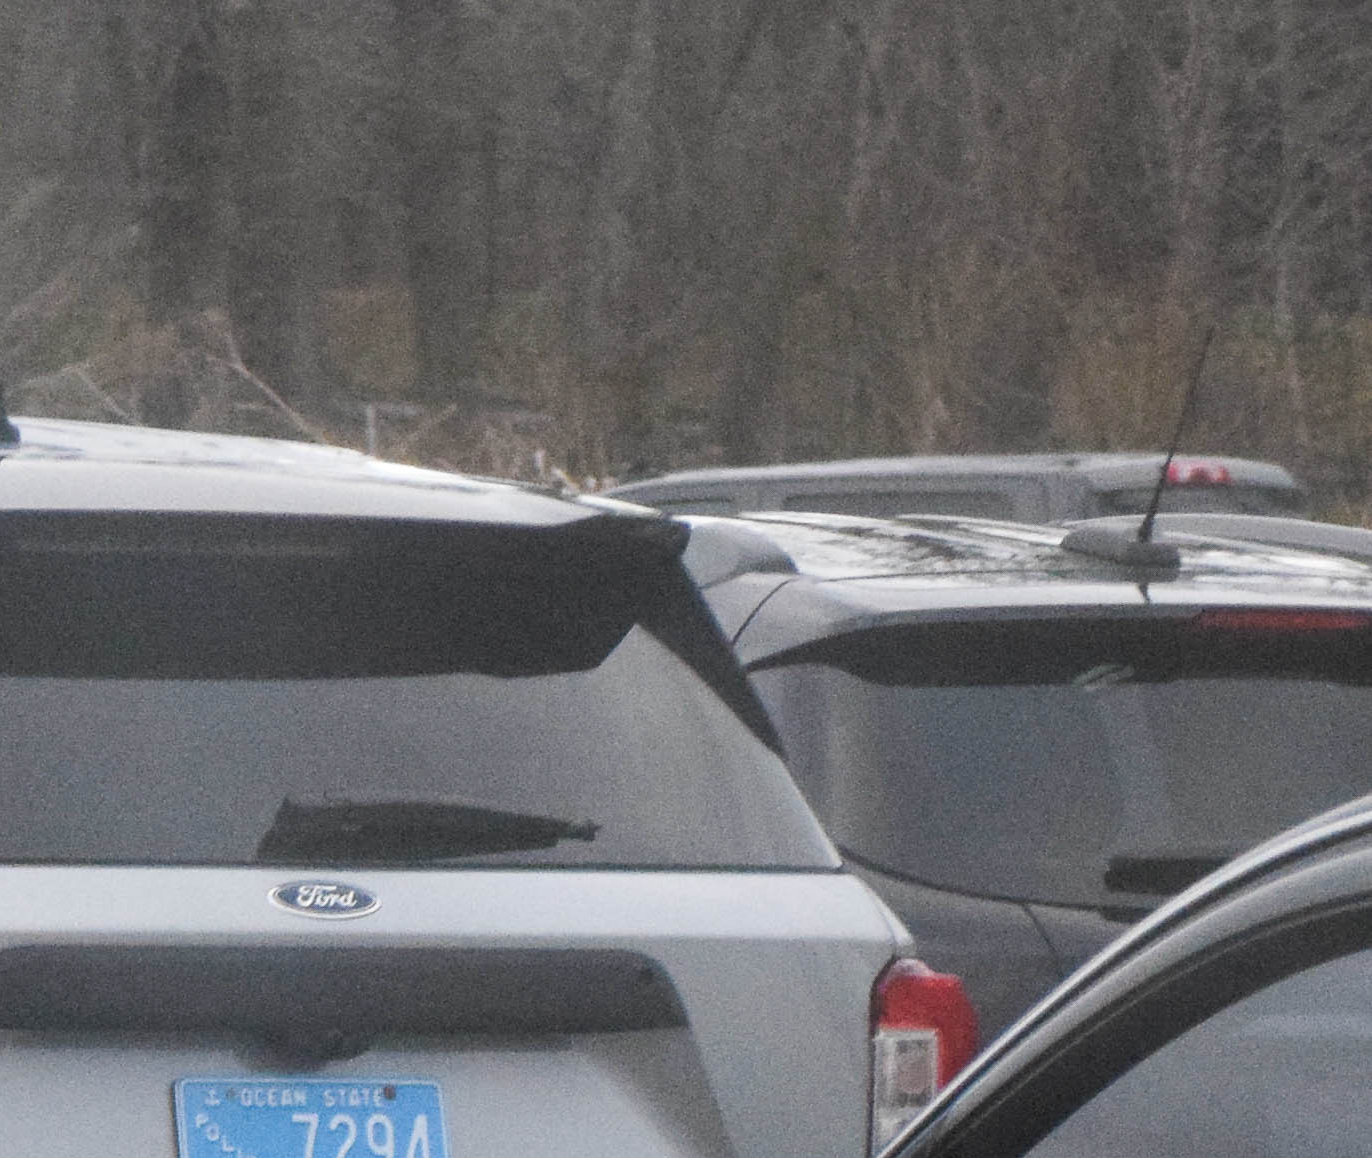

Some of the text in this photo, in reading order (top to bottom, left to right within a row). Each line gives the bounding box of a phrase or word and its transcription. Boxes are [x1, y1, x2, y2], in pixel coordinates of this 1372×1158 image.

[297, 884, 358, 907] Ford
[240, 1087, 384, 1107] OCEAN STATE
